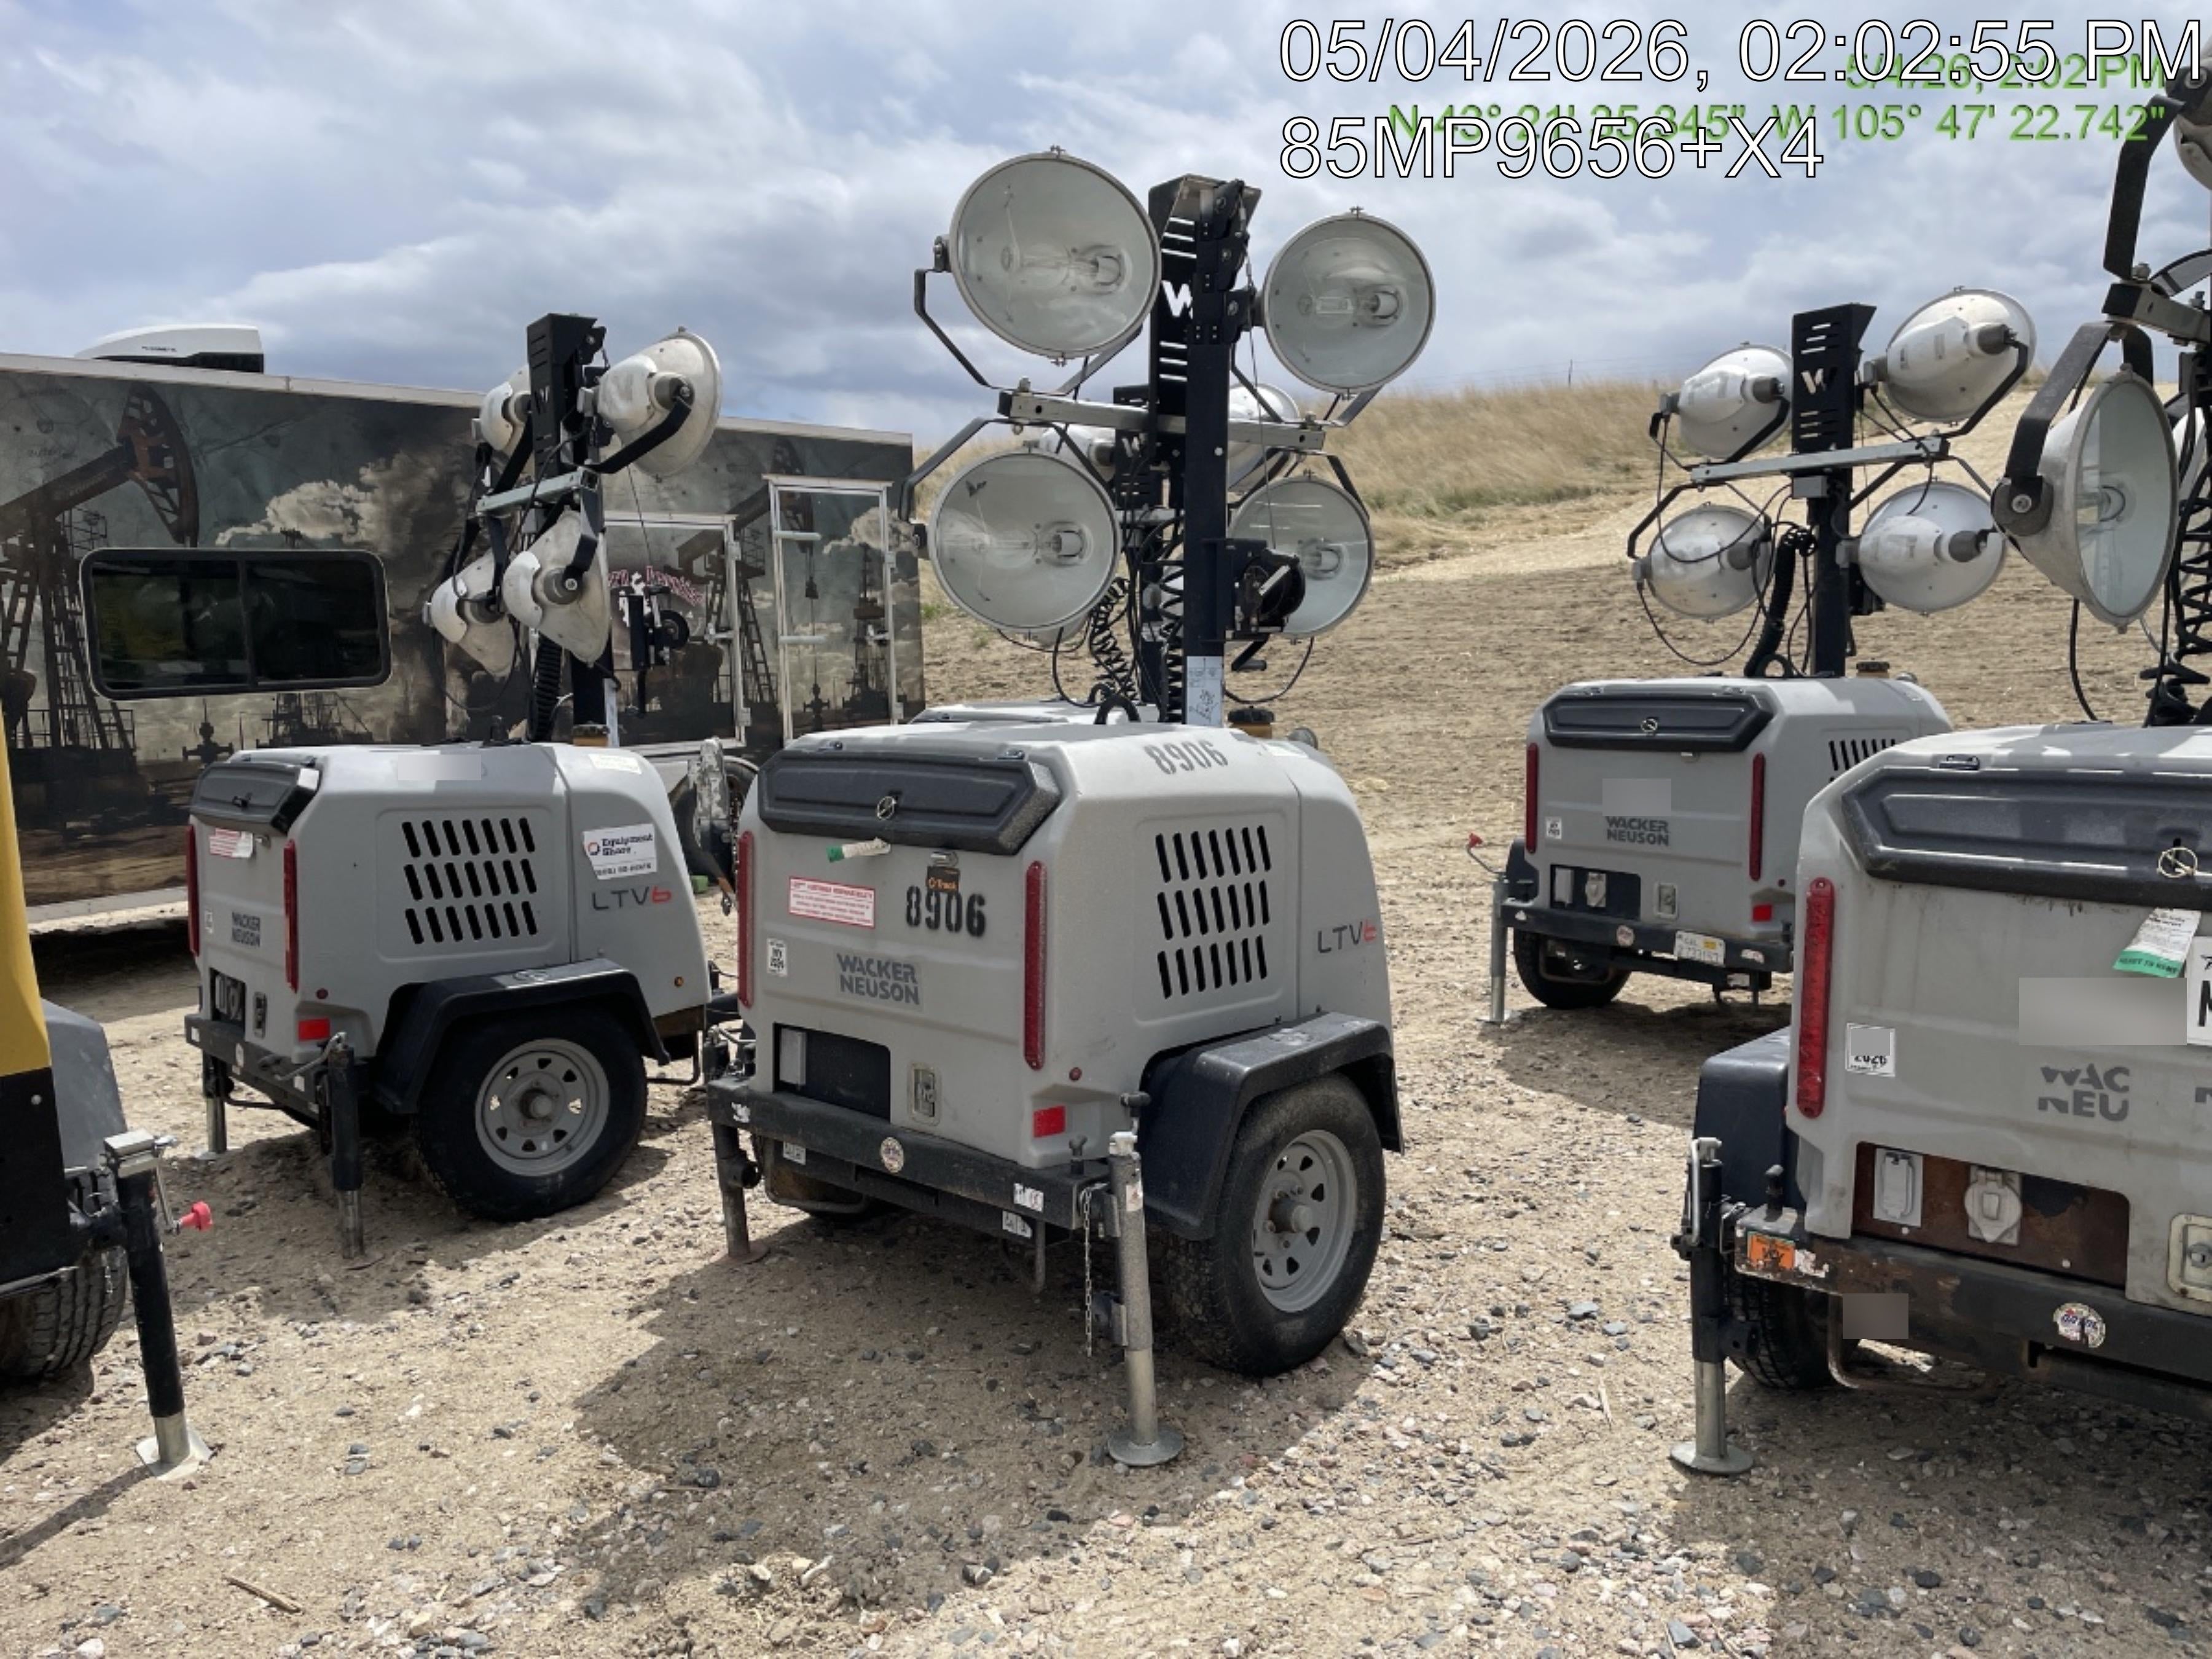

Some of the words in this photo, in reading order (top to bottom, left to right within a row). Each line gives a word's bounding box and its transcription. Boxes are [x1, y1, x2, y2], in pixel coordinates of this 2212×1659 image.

[1143, 739, 1228, 775] 8906
[1605, 816, 1669, 834] WACKER
[1606, 829, 1669, 846] NEUSON
[592, 885, 672, 911] LTV6
[906, 885, 986, 938] 8906
[836, 953, 918, 984] WACKER
[840, 975, 920, 1005] NEUSON
